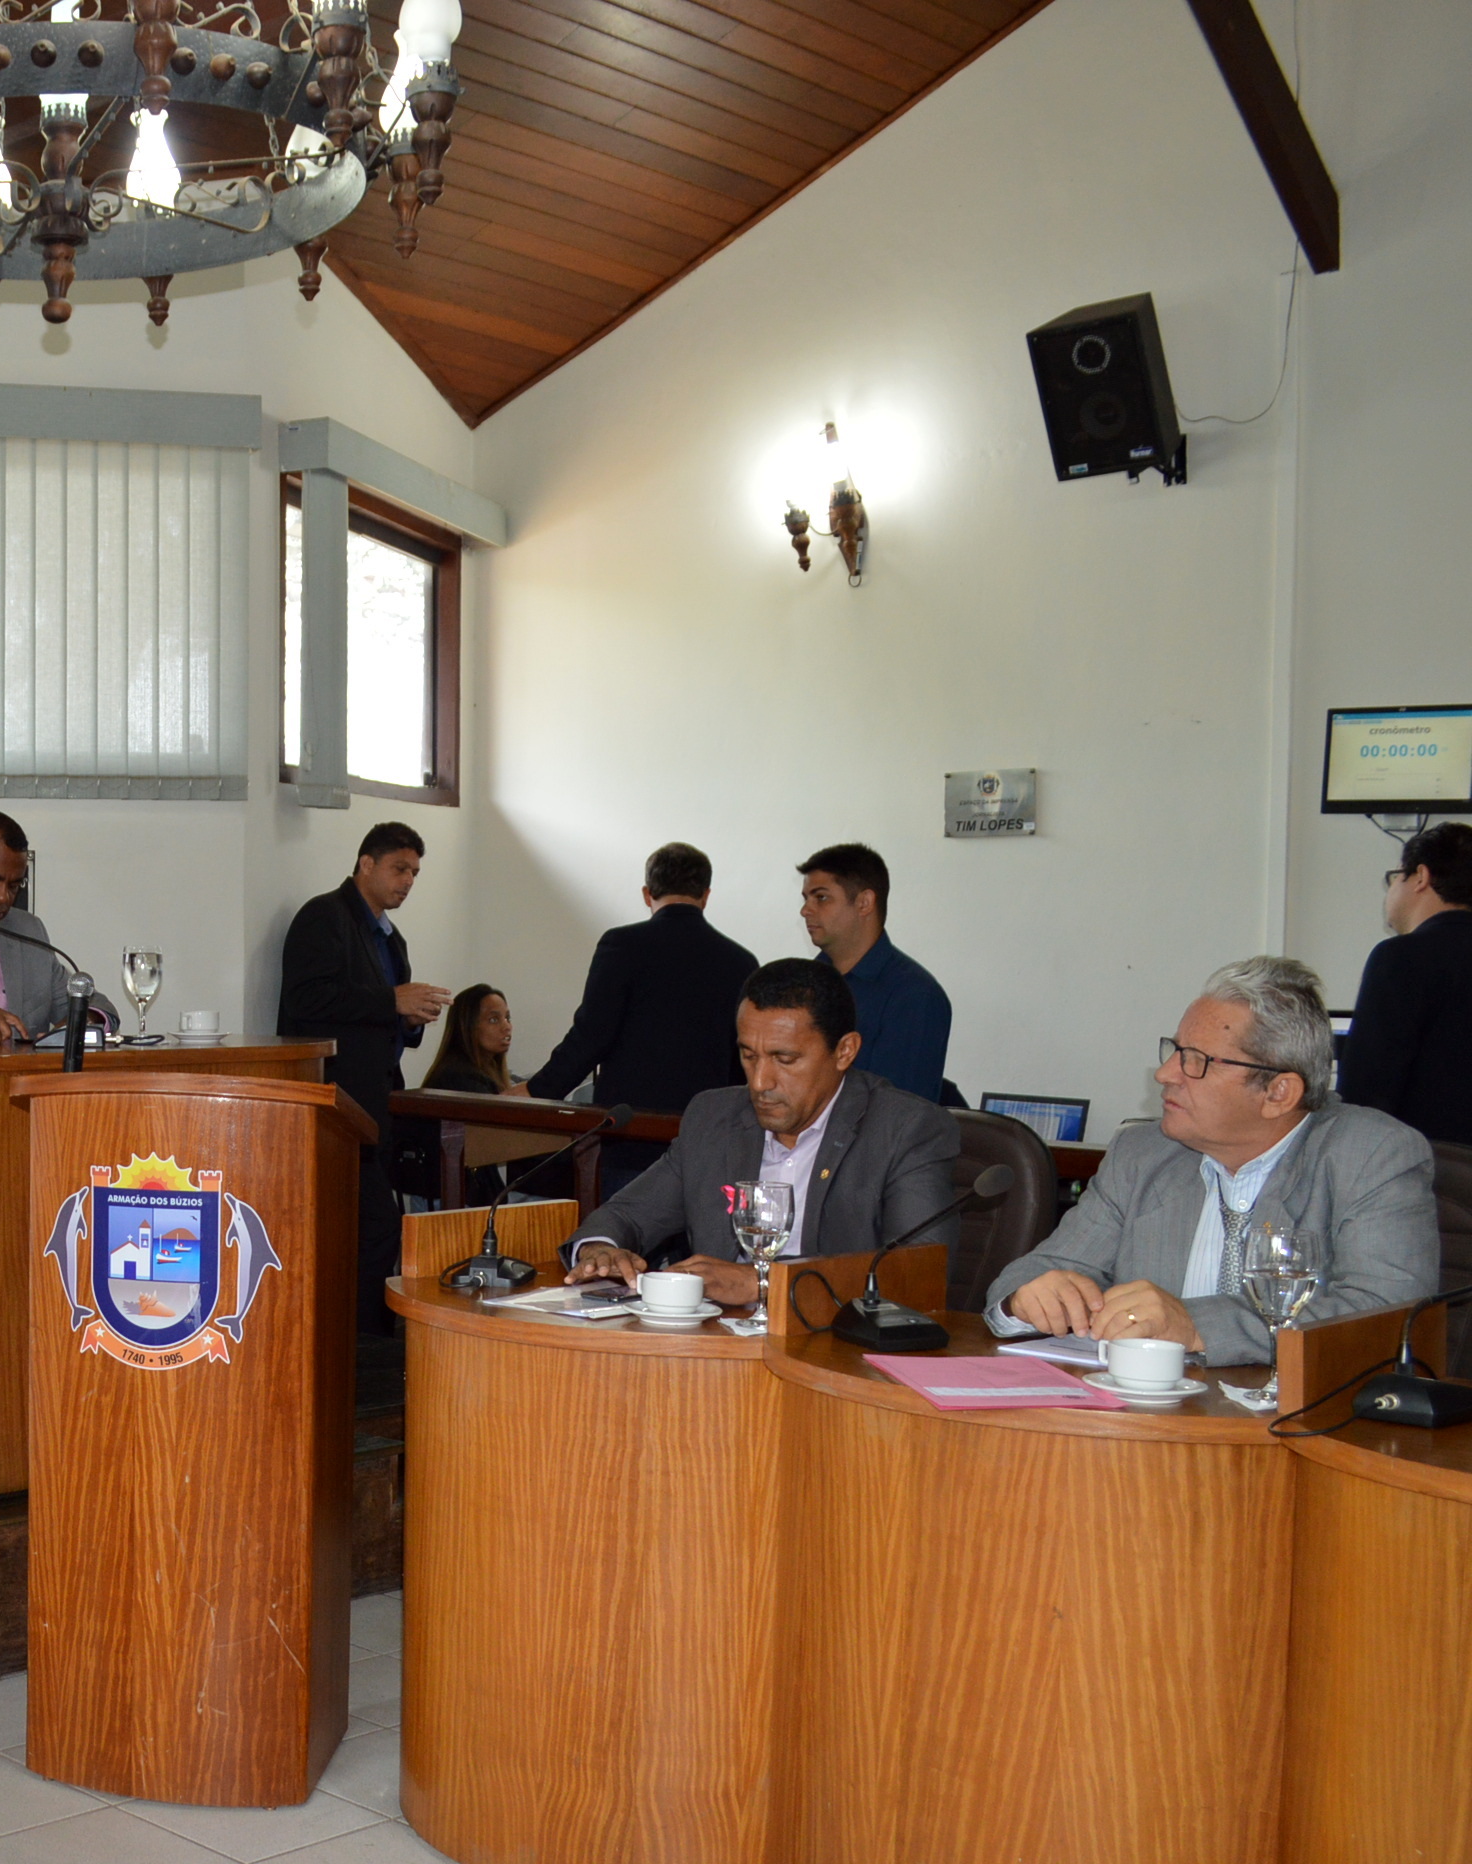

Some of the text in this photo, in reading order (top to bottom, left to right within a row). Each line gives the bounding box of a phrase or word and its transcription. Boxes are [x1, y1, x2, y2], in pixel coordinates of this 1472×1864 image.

[1360, 744, 1438, 757] 00:00:00
[956, 820, 977, 832] TIM
[979, 818, 1024, 831] LOPES
[108, 1194, 203, 1207] ARMAÇÃO DOS BÚZIOS
[121, 1348, 184, 1366] 1740 1995
